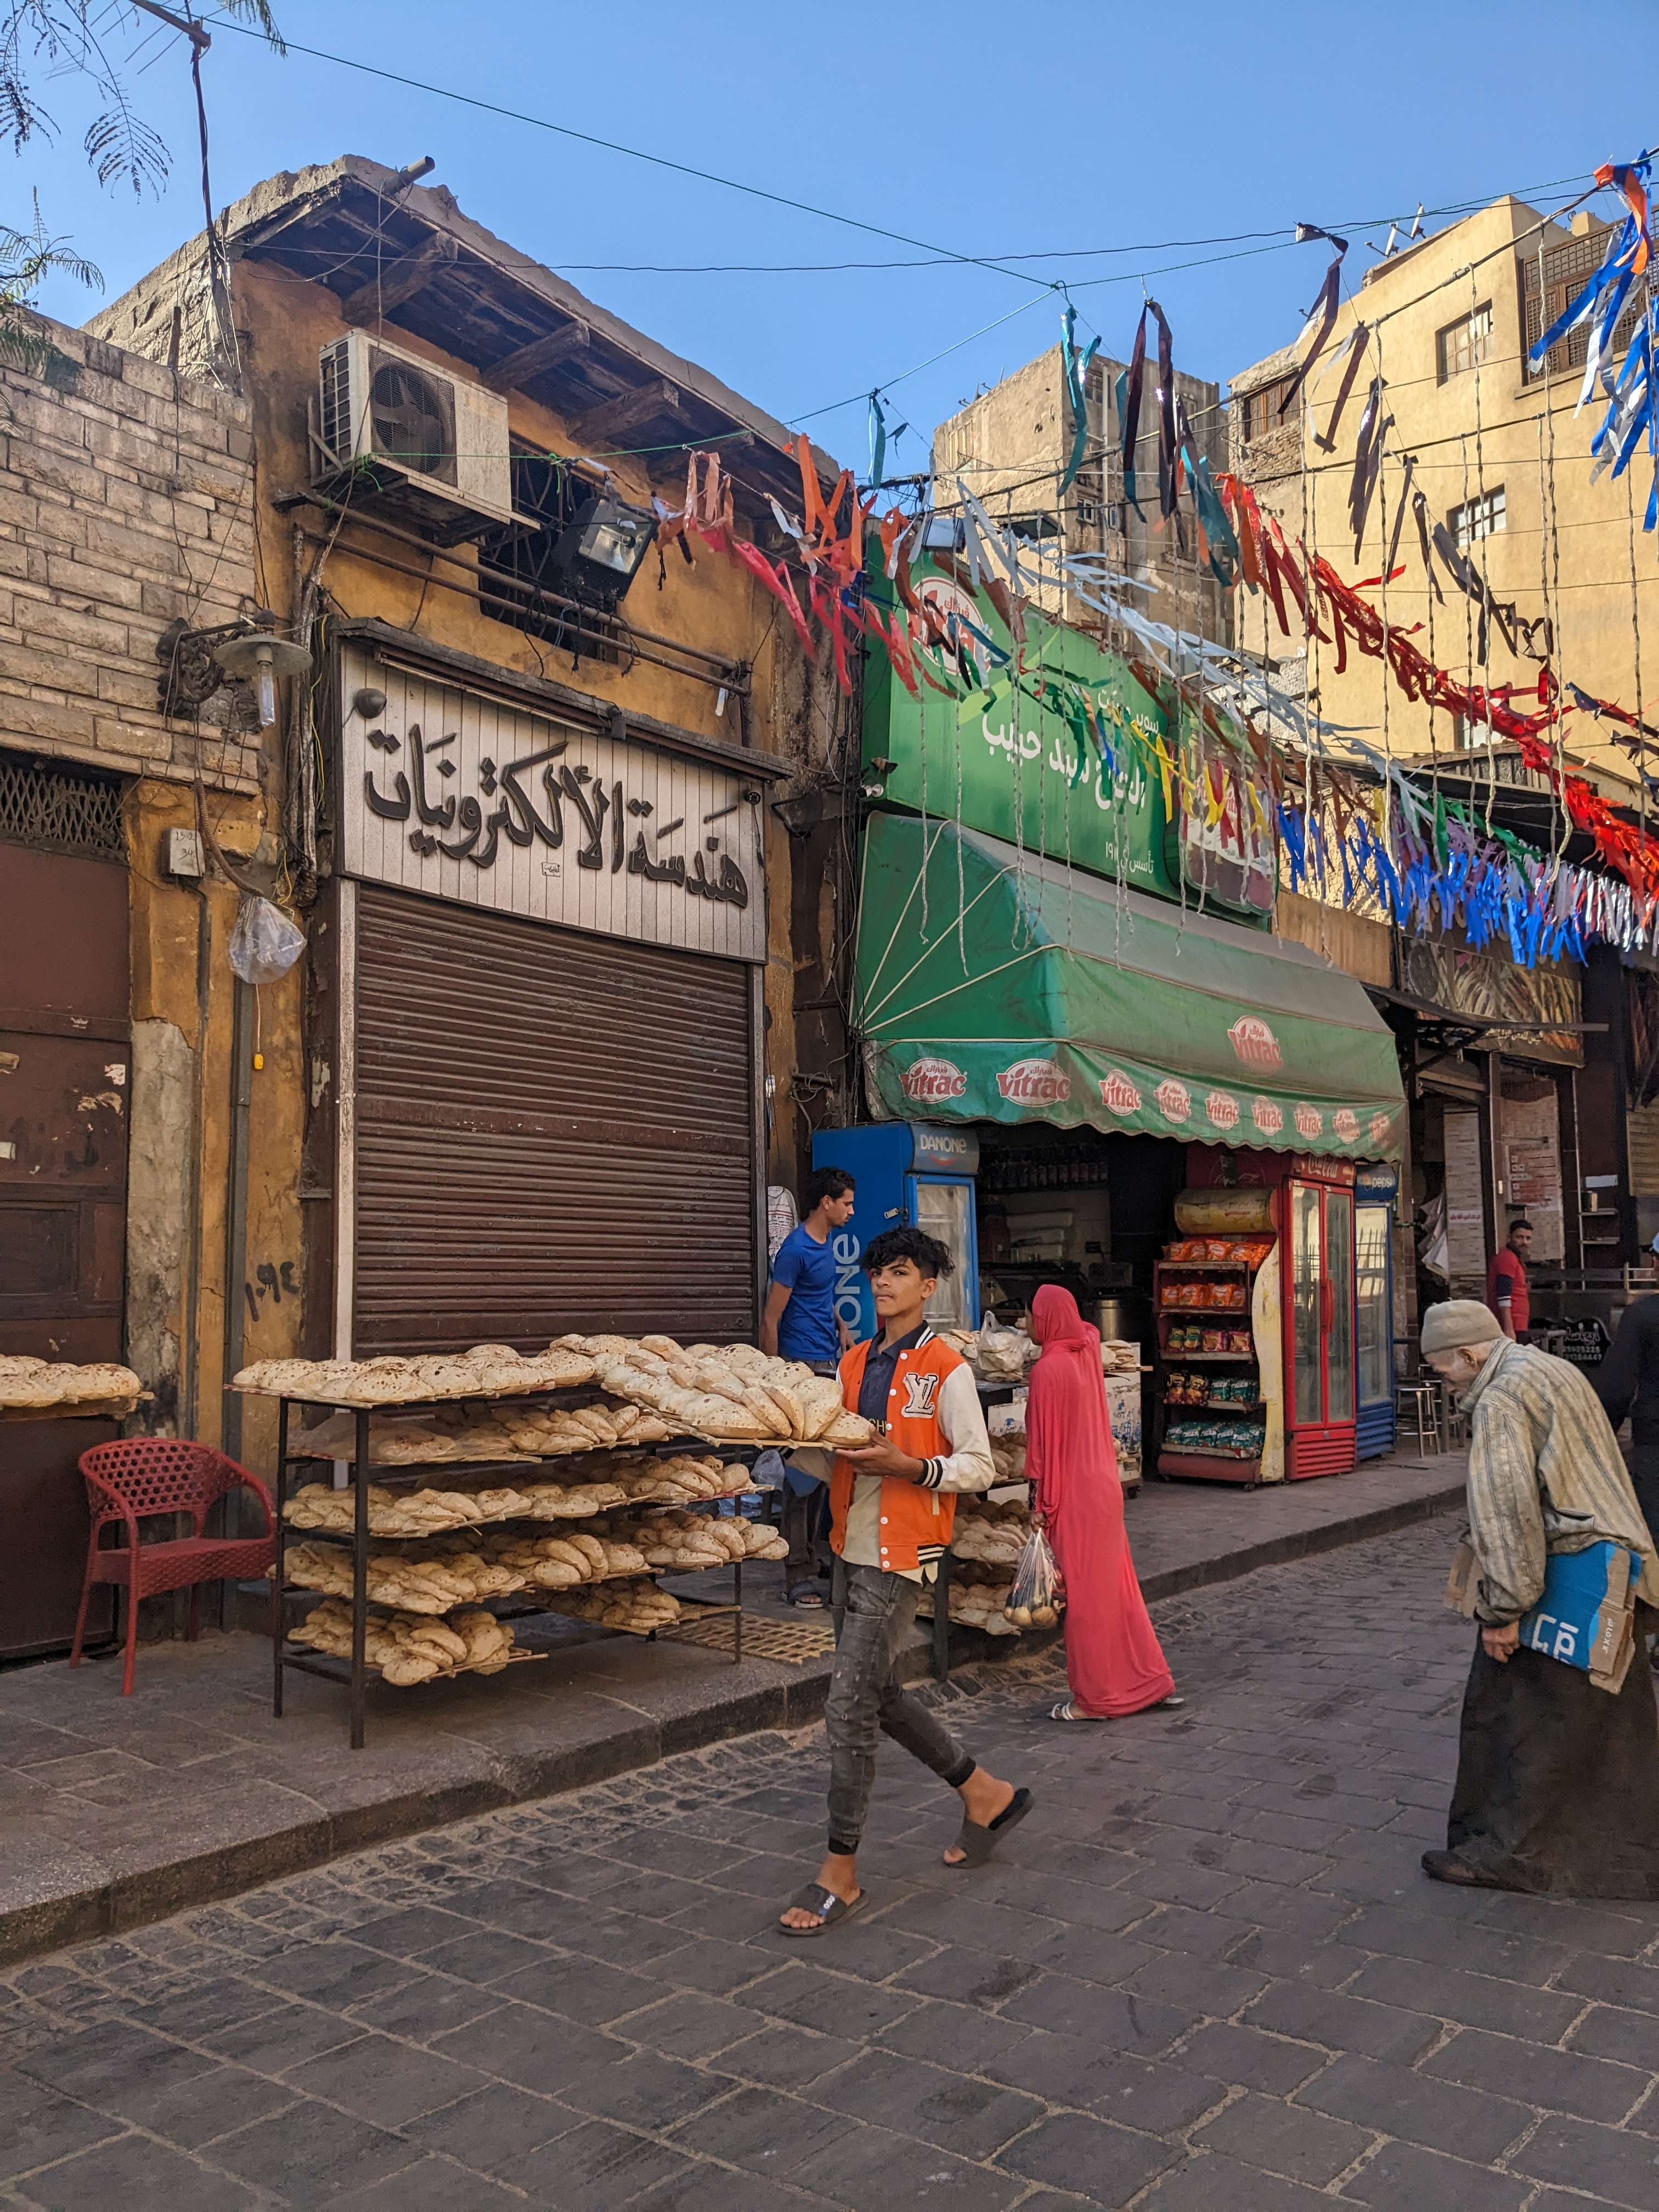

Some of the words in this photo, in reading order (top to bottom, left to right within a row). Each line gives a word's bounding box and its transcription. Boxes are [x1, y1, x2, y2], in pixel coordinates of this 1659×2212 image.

[982, 714, 1041, 767] حبيب
[628, 797, 748, 909] هندسة
[899, 1069, 966, 1096] Vitrac
[996, 1070, 1070, 1100] Vitrac
[1099, 1081, 1142, 1109] Vitrac
[1372, 1177, 1392, 1191] pepsi
